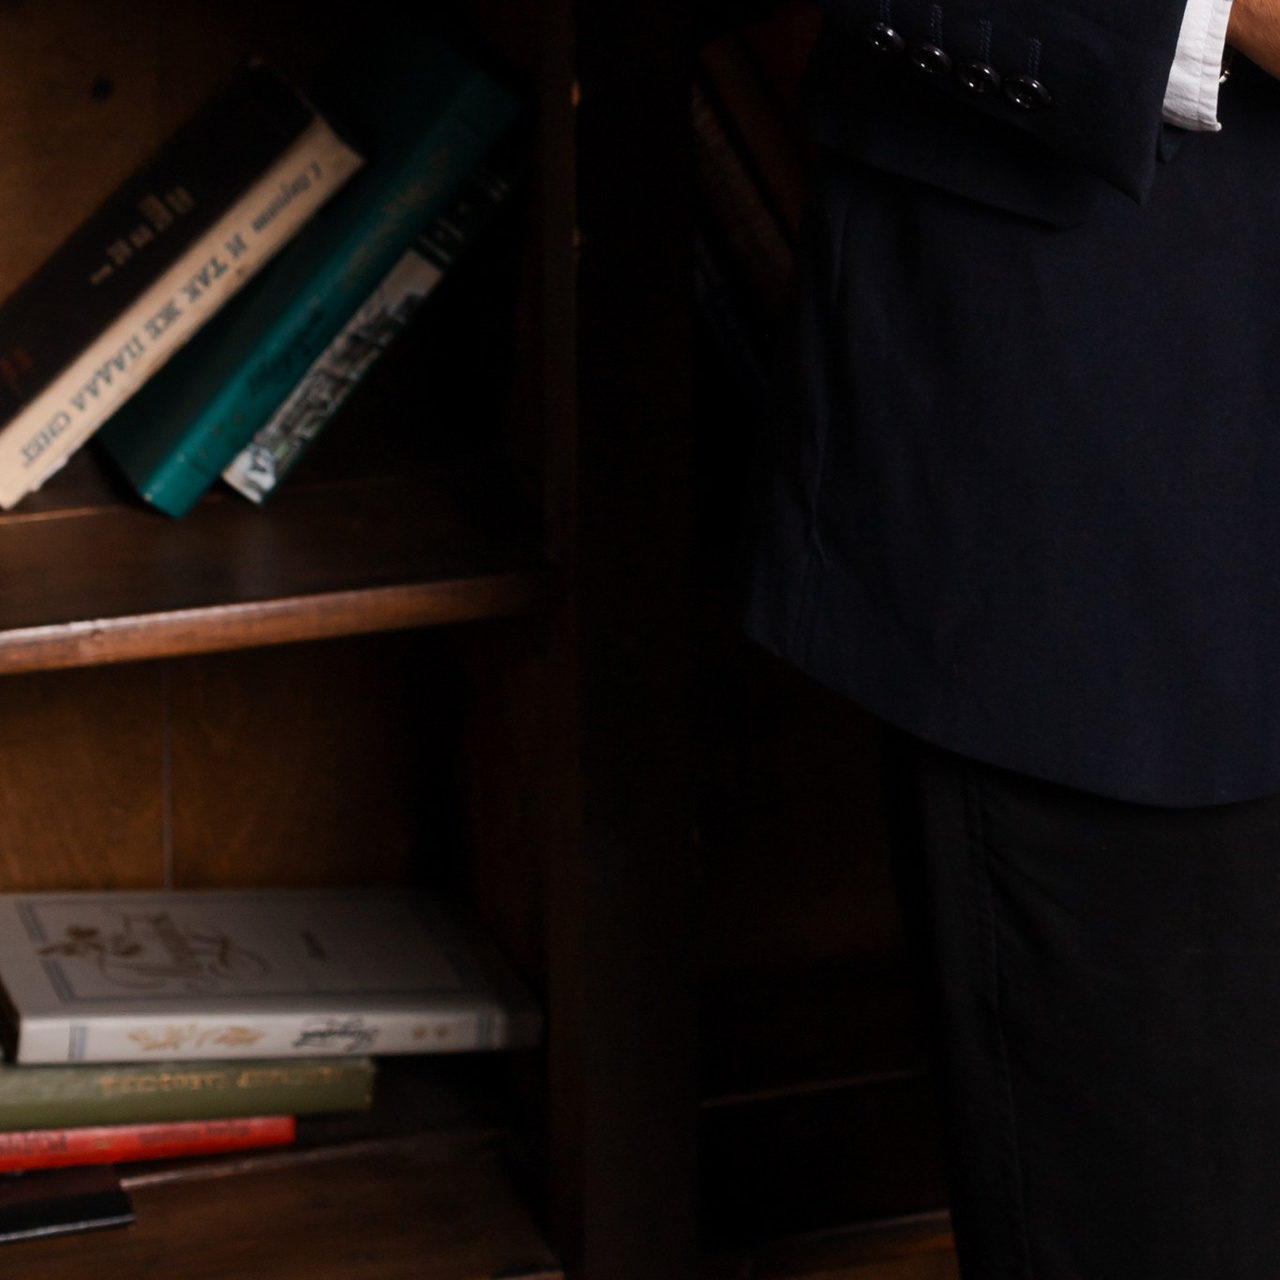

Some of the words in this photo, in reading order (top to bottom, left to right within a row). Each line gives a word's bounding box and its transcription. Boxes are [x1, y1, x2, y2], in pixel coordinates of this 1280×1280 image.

[180, 254, 226, 302] ТАК
[143, 300, 182, 338] ЖЕ
[15, 408, 71, 467] СНЕГ
